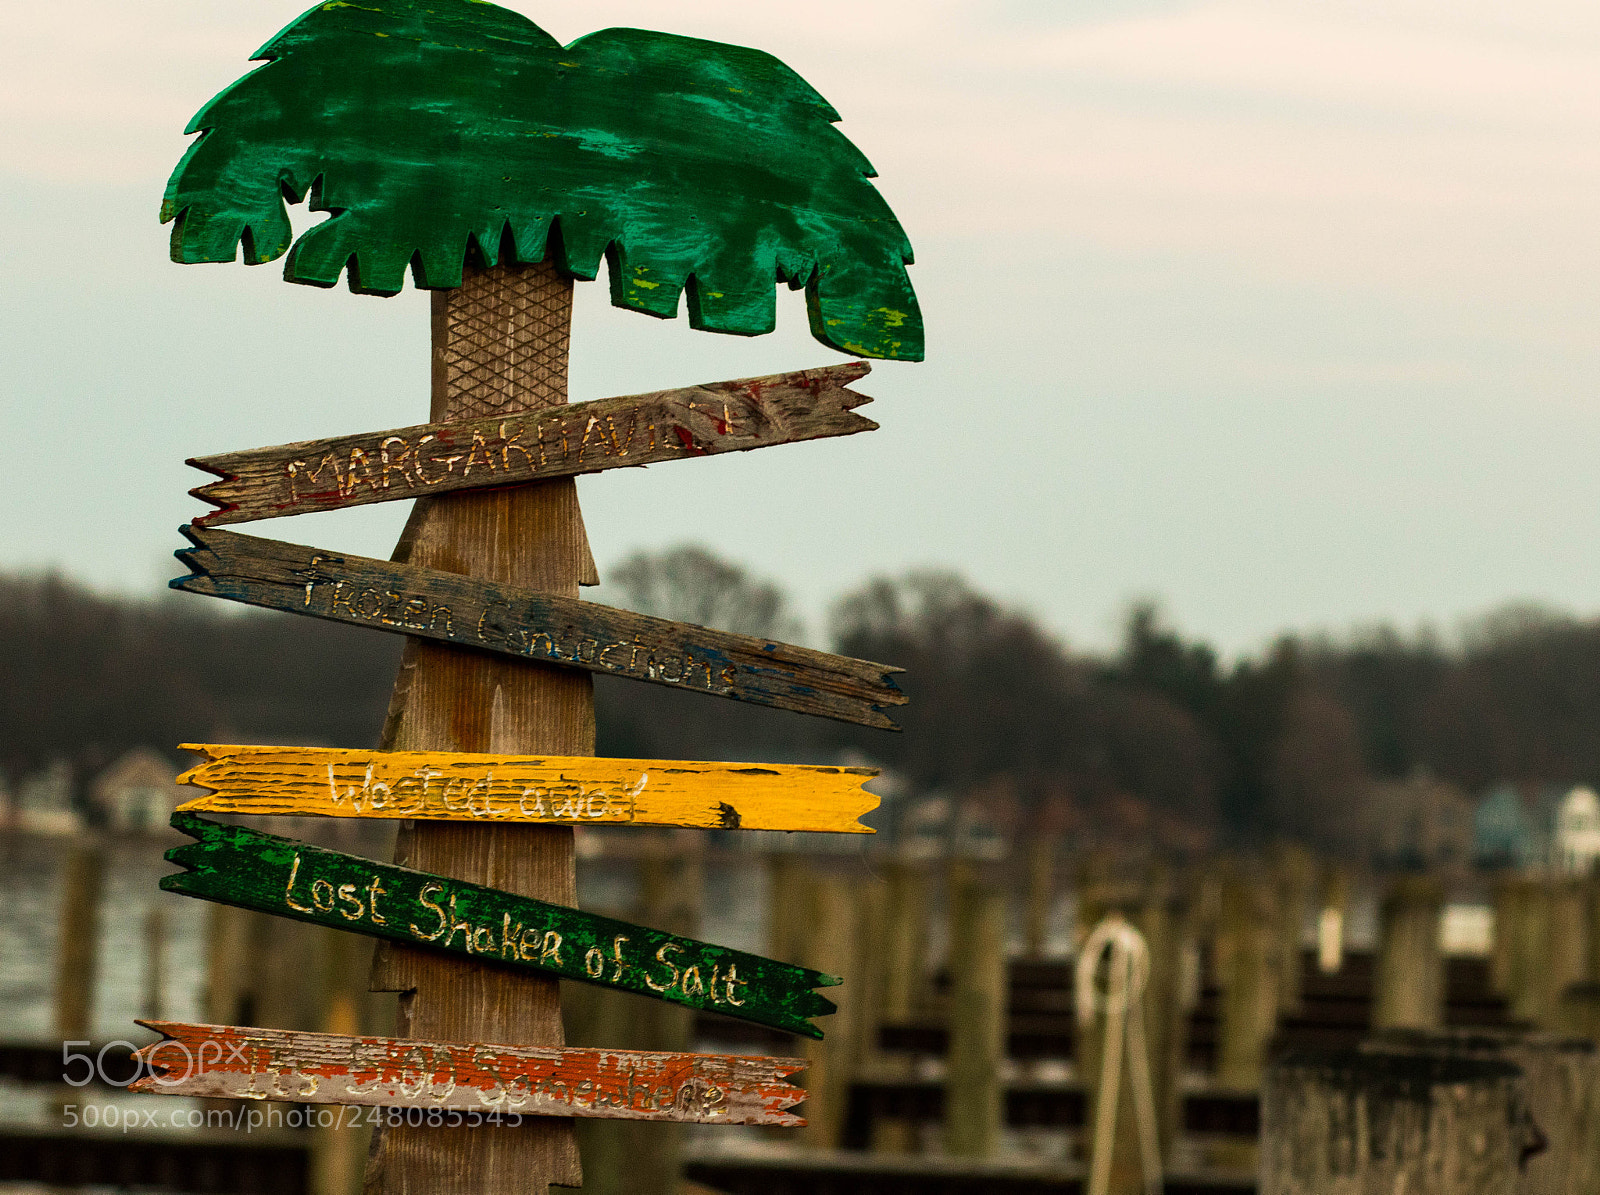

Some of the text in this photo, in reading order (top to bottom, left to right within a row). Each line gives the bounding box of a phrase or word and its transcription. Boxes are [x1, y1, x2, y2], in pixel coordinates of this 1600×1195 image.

[286, 402, 757, 501] MARGARITAVILE
[284, 852, 387, 922] Lost
[584, 934, 630, 982] of
[643, 941, 747, 1008] Salt
